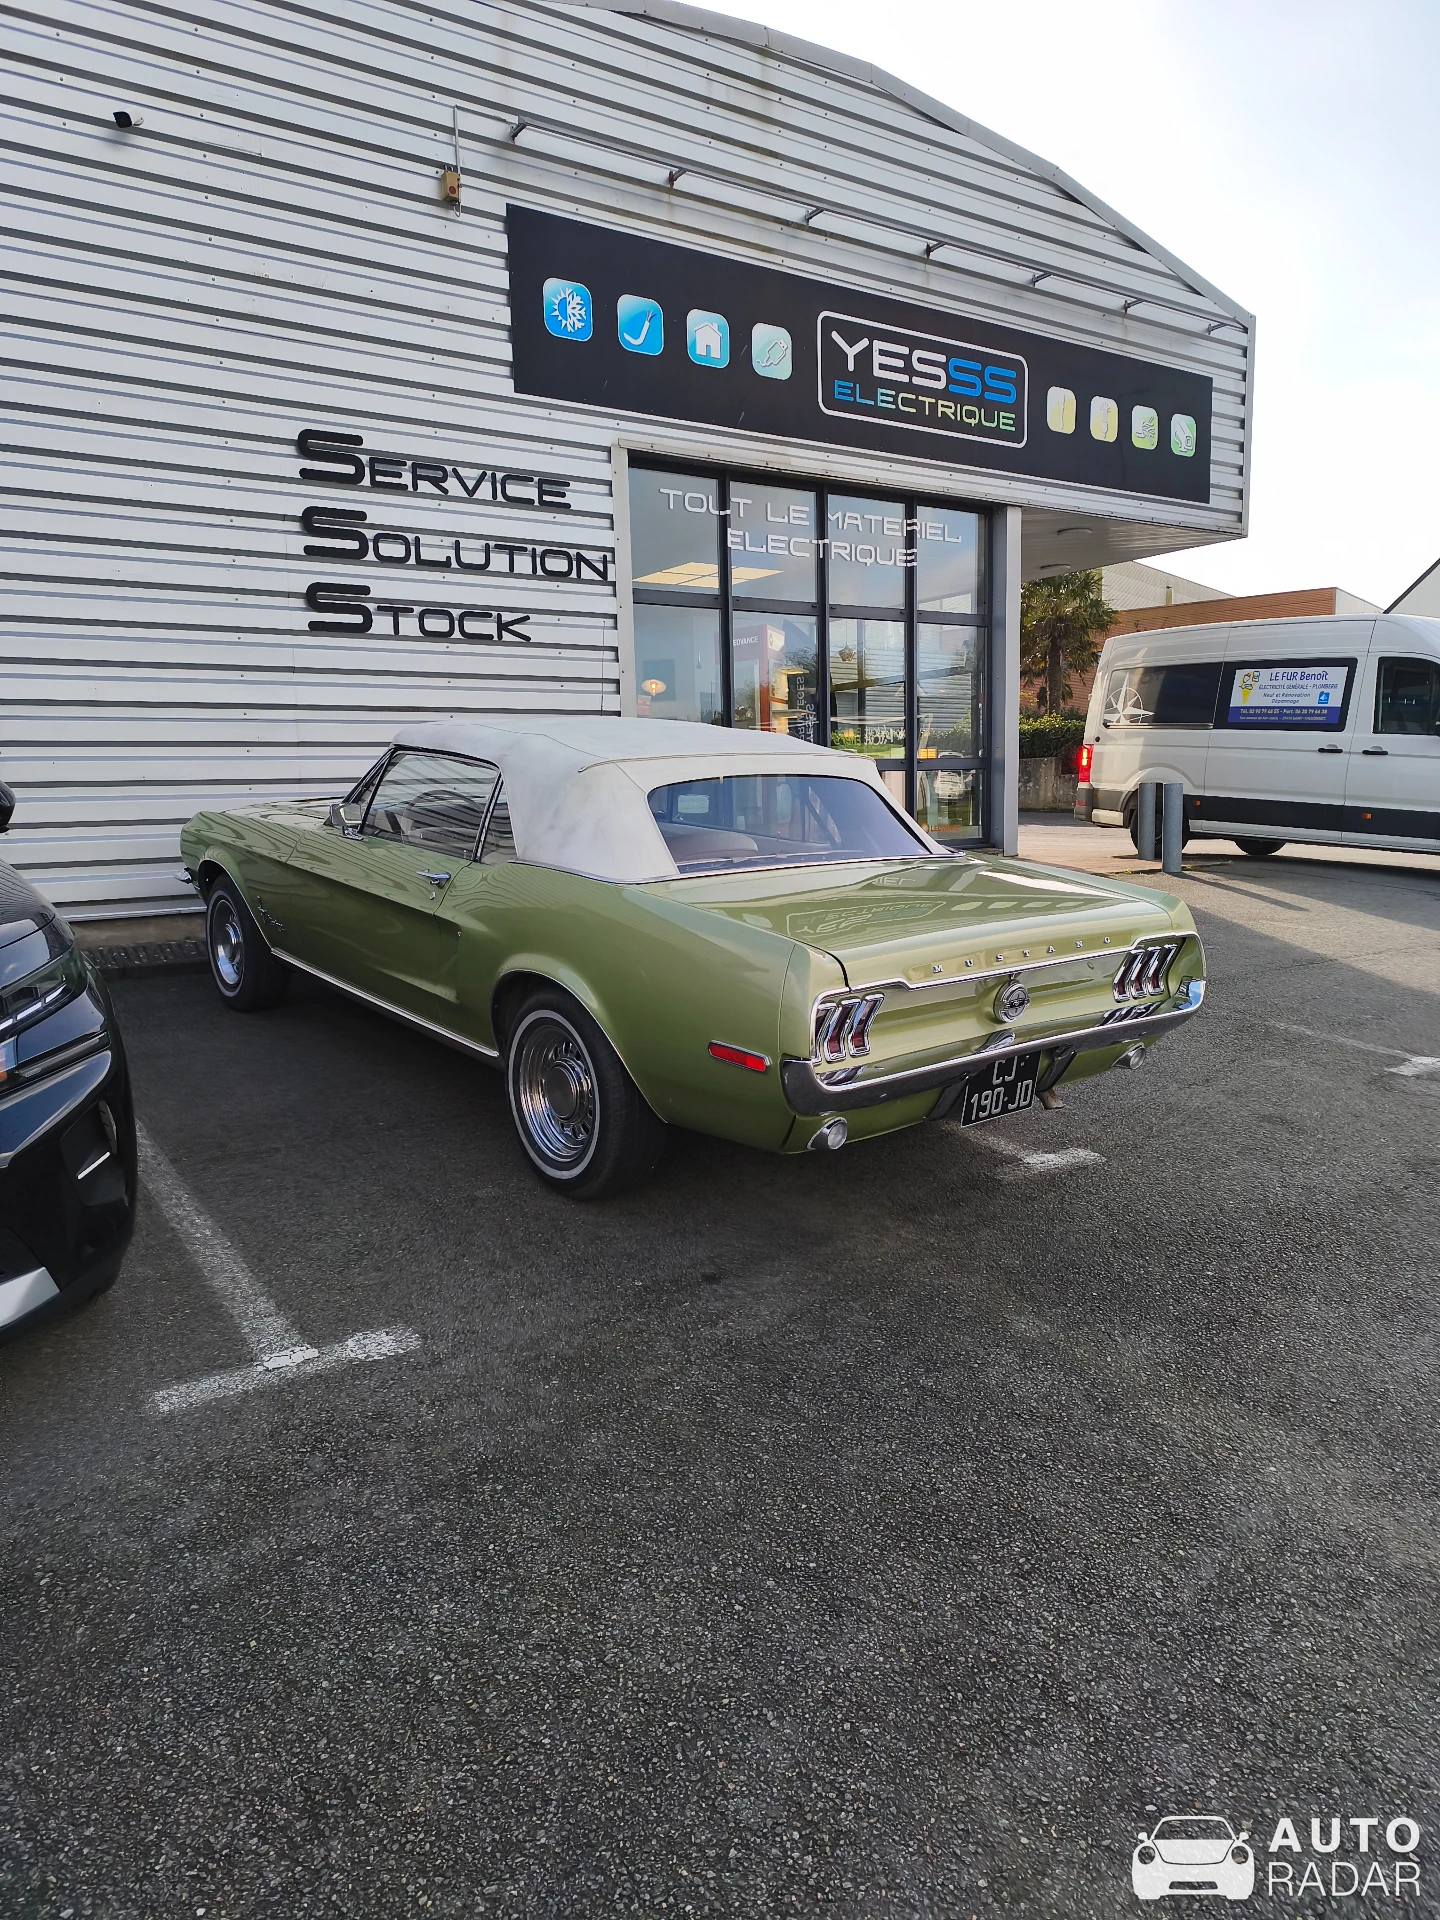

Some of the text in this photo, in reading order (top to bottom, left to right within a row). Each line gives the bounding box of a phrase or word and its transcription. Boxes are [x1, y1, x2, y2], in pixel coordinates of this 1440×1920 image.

[831, 330, 1017, 404] YESSS
[834, 379, 1016, 431] ELECTRIQUE
[297, 428, 571, 509] SERVICE
[659, 488, 962, 543] TOUT LE MATERIEL
[302, 505, 608, 581] SOLUTION
[727, 527, 918, 567] ELECTRIQUE
[305, 581, 531, 642] STOCK
[733, 635, 759, 646] EDVANCE
[1270, 670, 1328, 681] LE FUR Benoît
[933, 936, 1111, 973] MUSTANG
